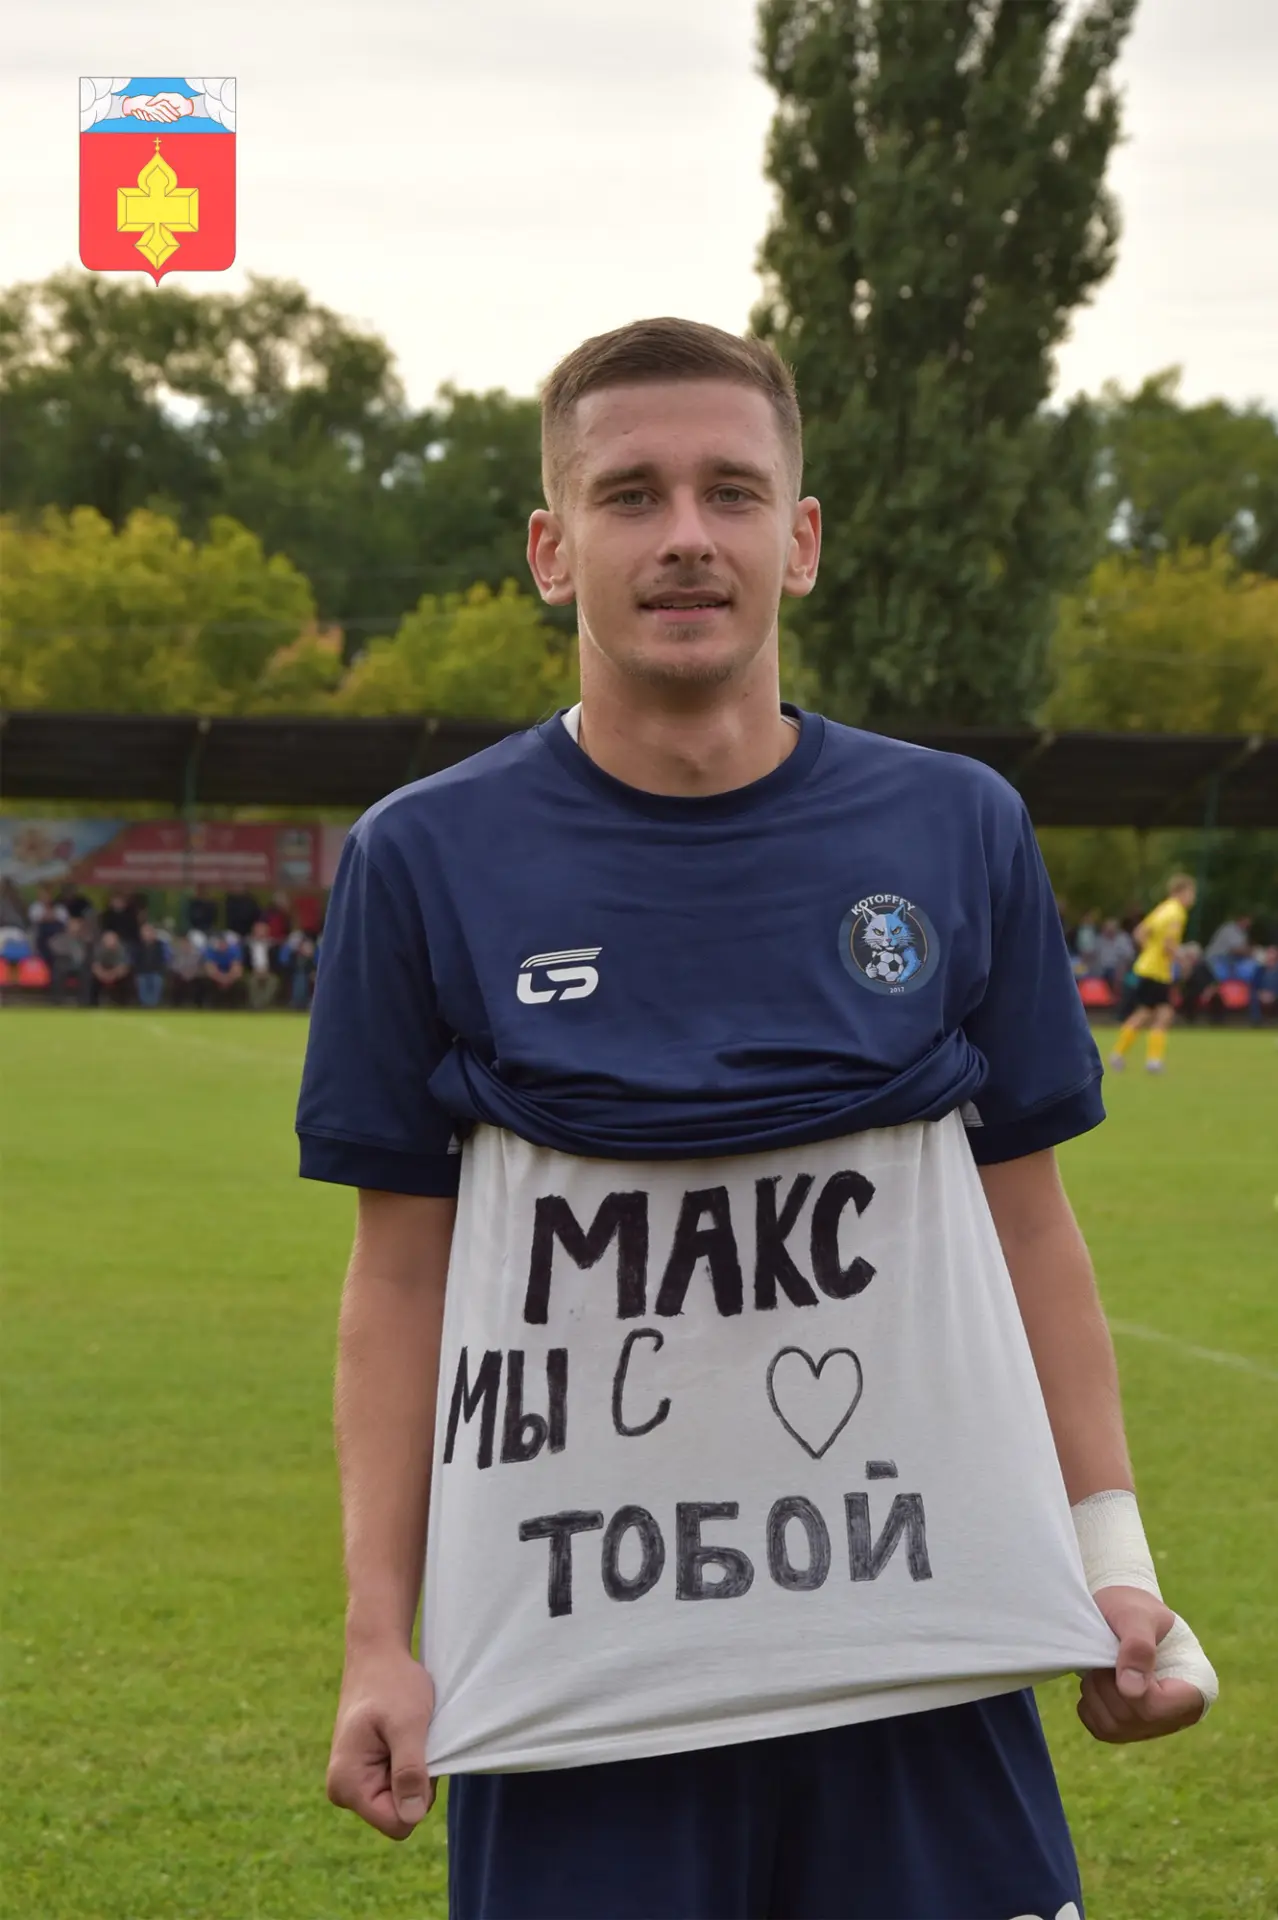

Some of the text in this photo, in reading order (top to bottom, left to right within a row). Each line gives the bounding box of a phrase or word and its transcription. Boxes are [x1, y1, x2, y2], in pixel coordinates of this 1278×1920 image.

[523, 1170, 876, 1324] МАКС
[443, 1328, 671, 1469] МЫ С
[518, 1460, 933, 1617] ТОБОЙ
